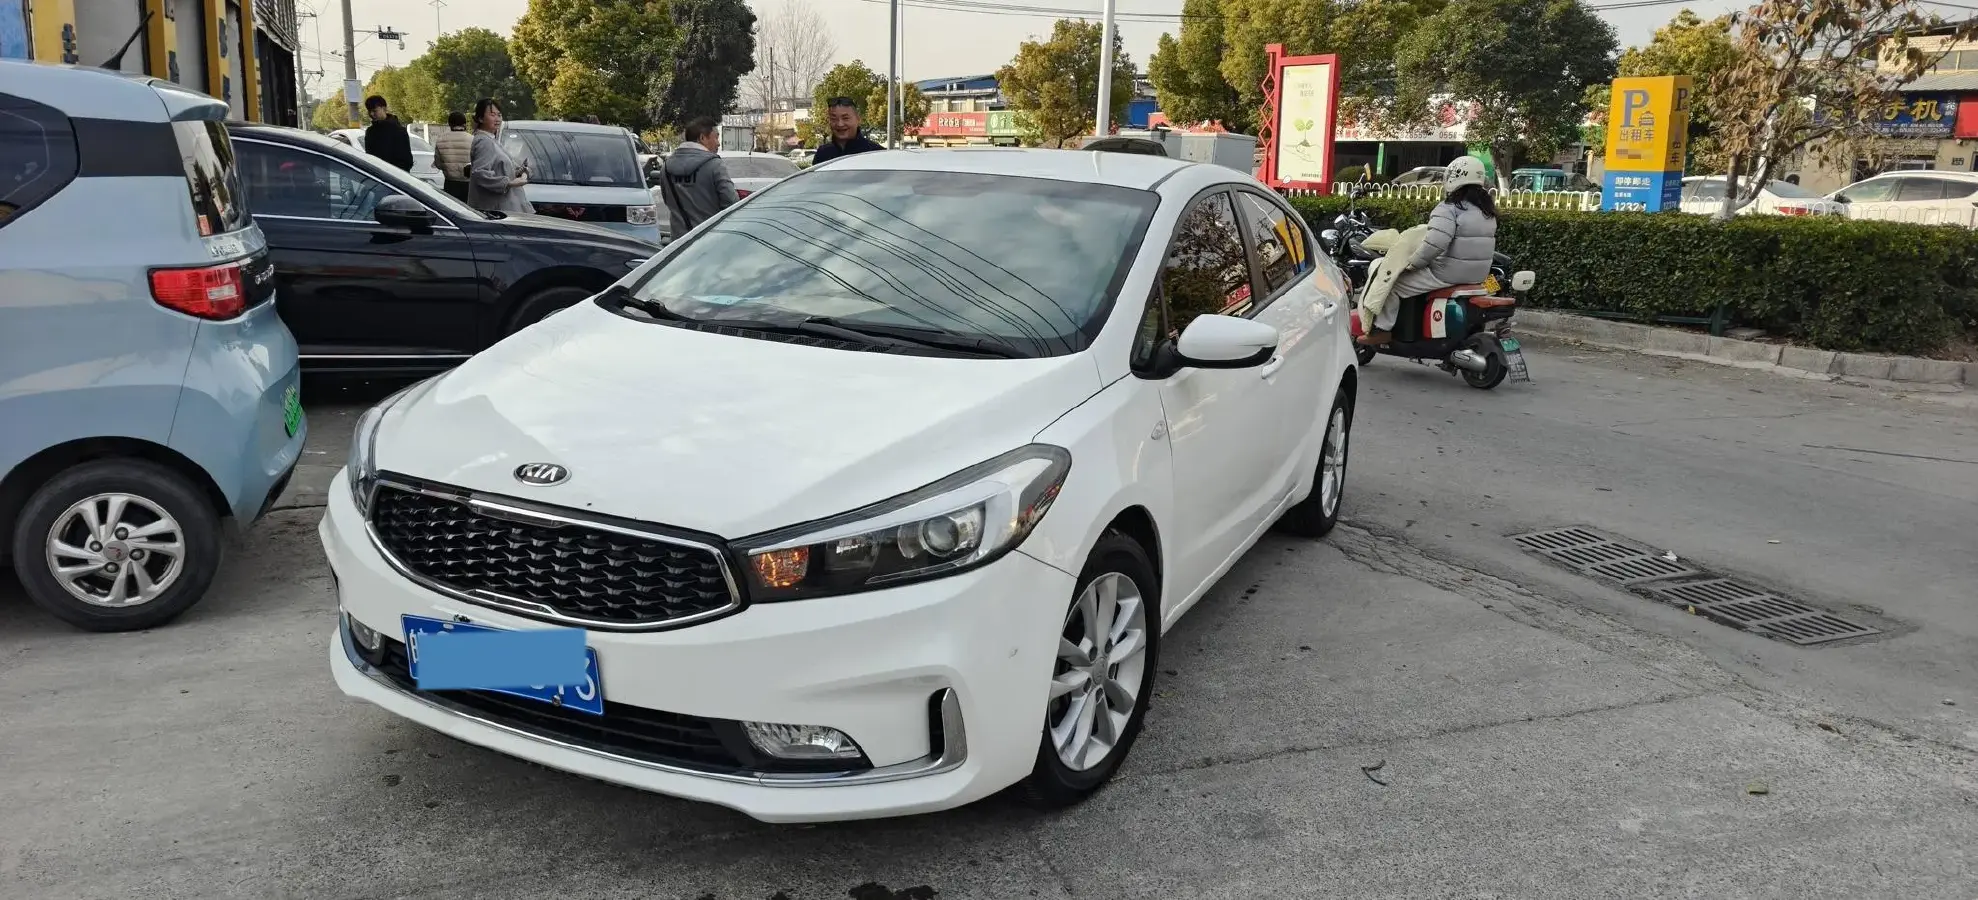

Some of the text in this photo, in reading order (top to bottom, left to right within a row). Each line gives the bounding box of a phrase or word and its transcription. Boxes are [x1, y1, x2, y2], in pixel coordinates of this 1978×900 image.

[1620, 89, 1650, 127] P
[1619, 129, 1655, 141] 出租车
[520, 464, 559, 482] KIA
